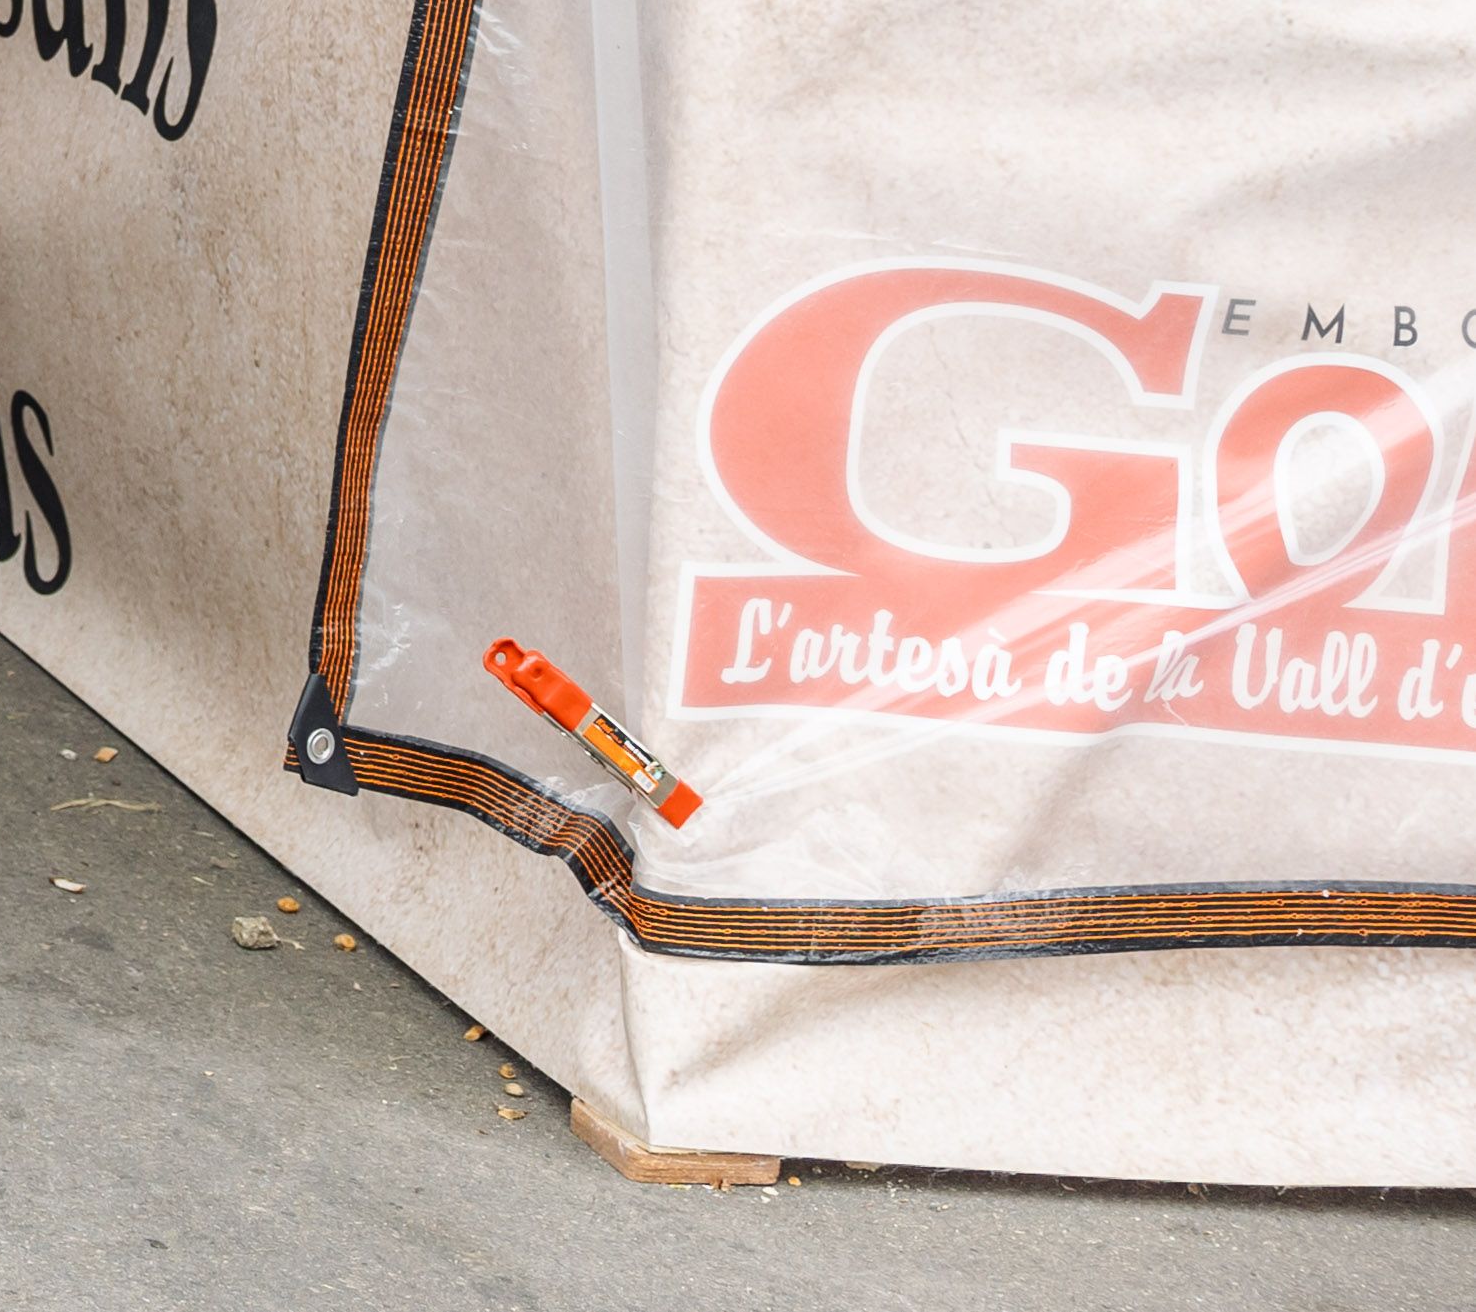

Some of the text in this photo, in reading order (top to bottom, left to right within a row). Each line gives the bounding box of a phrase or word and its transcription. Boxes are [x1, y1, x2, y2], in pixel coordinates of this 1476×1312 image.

[698, 257, 1476, 607] Go
[721, 597, 1023, 701] L'artesà
[1044, 622, 1133, 711] de
[1143, 630, 1204, 703] la
[1231, 624, 1378, 719] Vall
